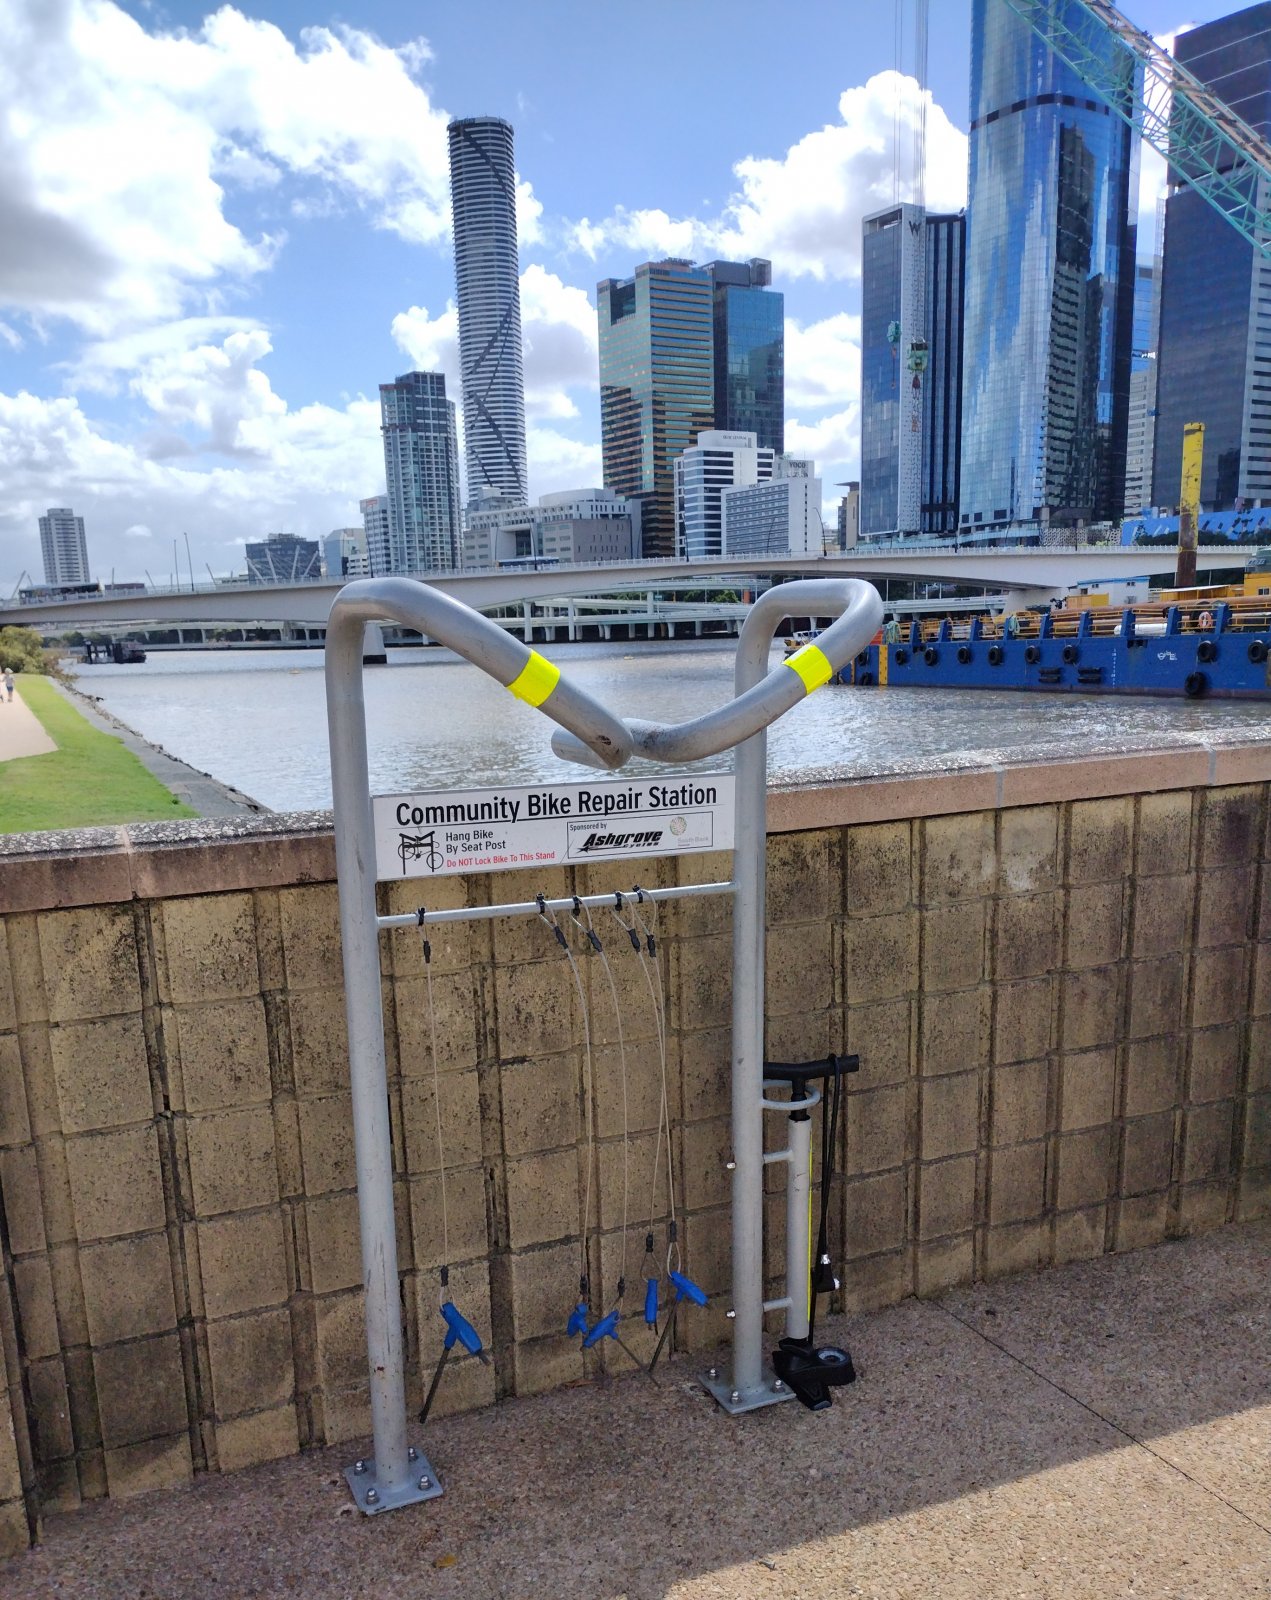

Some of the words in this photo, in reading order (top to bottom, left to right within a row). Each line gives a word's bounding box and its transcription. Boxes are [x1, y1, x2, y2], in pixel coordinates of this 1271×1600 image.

[396, 796, 520, 825] Community
[528, 793, 571, 817] Bike
[578, 787, 642, 816] Repair
[649, 783, 716, 808] Station
[569, 822, 599, 831] Sponsored
[600, 821, 607, 829] by
[445, 831, 471, 842] Hang
[473, 829, 494, 840] Bike
[583, 830, 663, 847] Ashgrove
[446, 844, 458, 855] By
[461, 842, 483, 853] Seat
[485, 840, 506, 850] Post
[447, 859, 457, 868] Do
[458, 858, 473, 867] NOT
[475, 857, 491, 866] Lock
[493, 855, 508, 864] Bike
[510, 854, 518, 862] To
[520, 852, 534, 862] This
[535, 850, 555, 860] Stand
